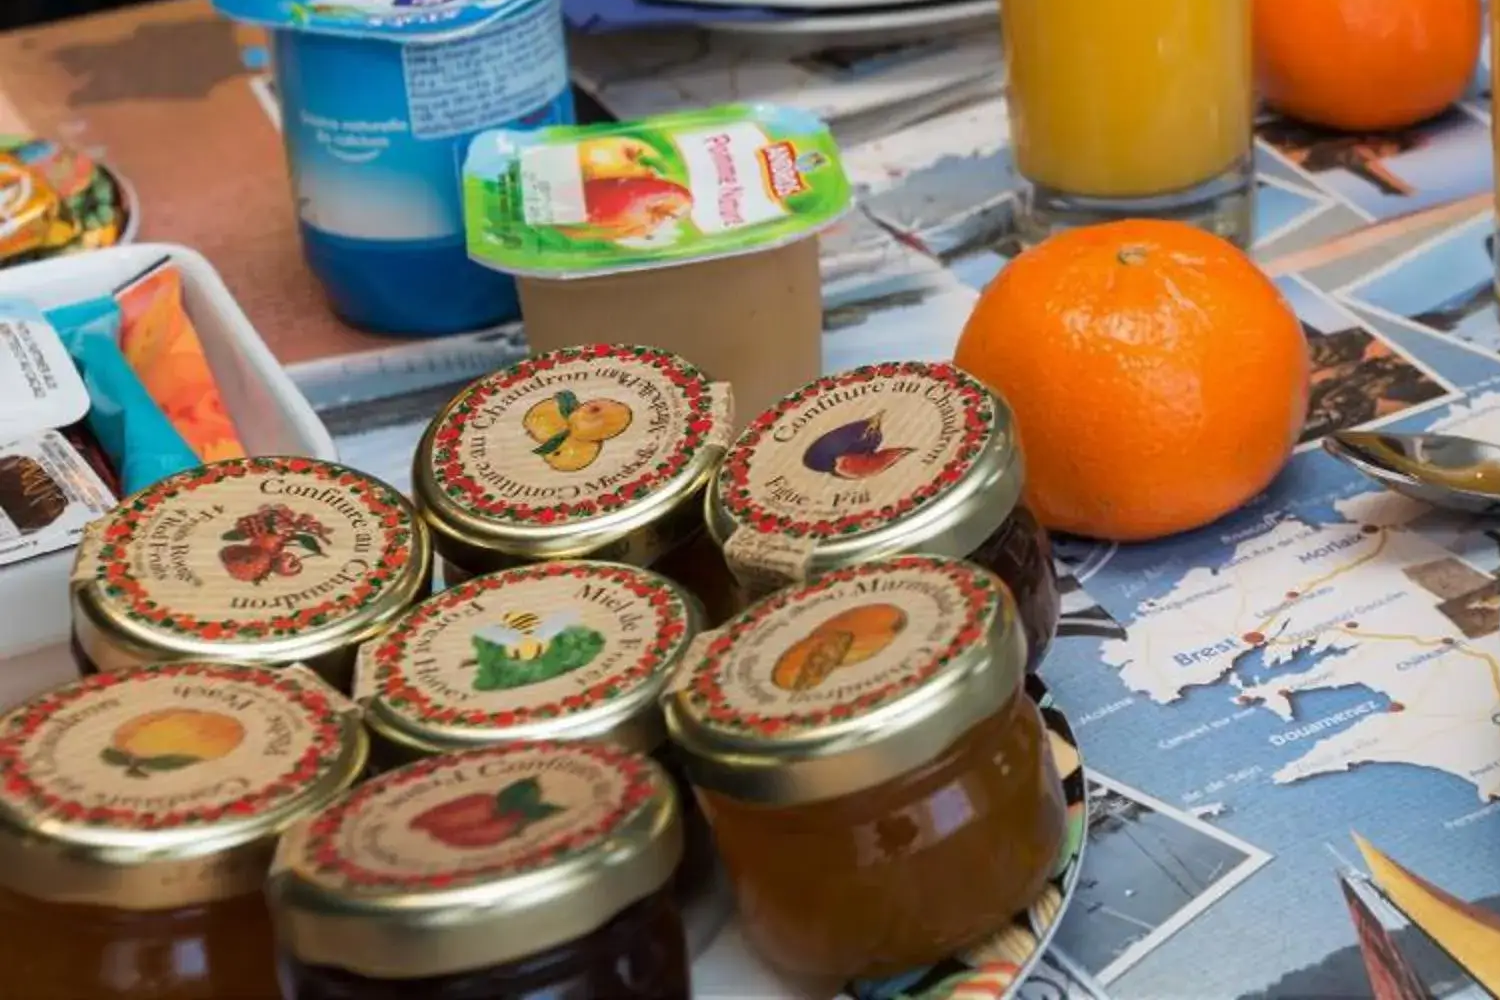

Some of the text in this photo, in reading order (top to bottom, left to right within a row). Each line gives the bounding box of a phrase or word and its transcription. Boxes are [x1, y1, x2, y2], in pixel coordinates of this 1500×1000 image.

[470, 371, 589, 499] Confiture au Chaudron
[773, 378, 964, 467] Confiture au Chaudron
[230, 476, 373, 610] Confiture au Chaudron
[411, 600, 486, 655] Forest
[573, 582, 626, 615] Miel
[617, 610, 640, 633] de
[1172, 637, 1240, 668] Brest
[172, 684, 254, 711] Peach
[413, 658, 471, 701] Honey
